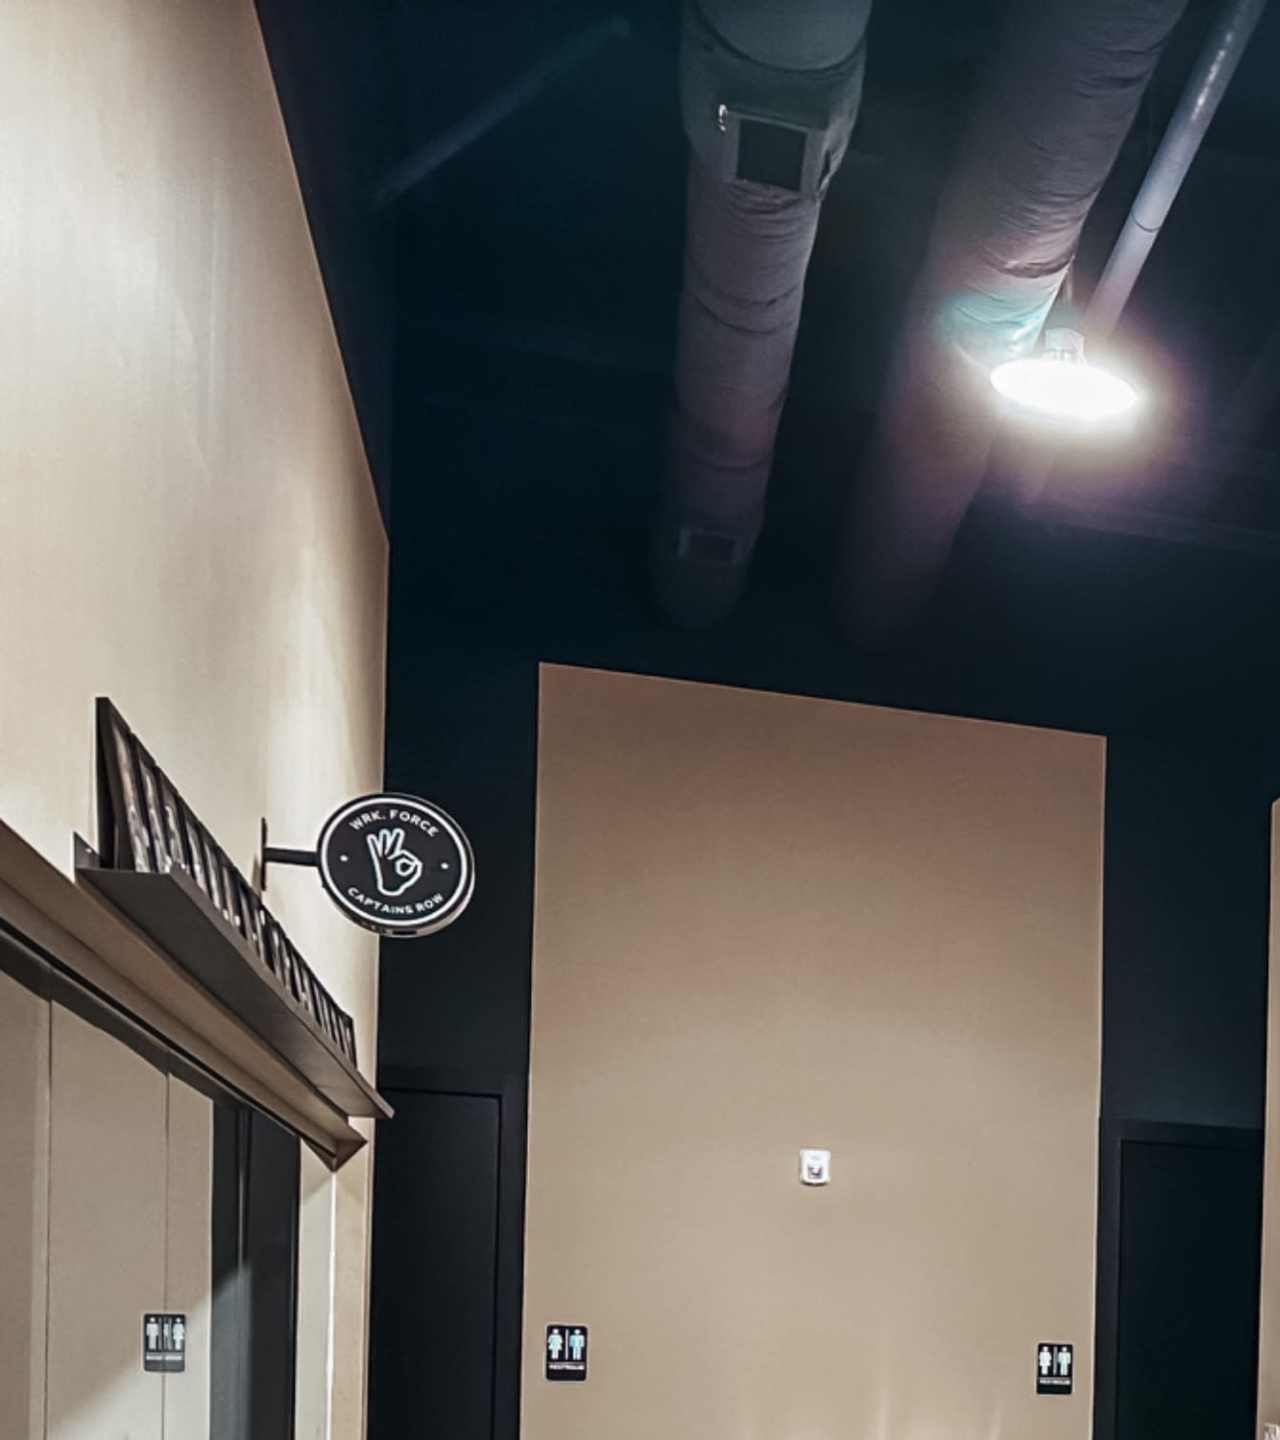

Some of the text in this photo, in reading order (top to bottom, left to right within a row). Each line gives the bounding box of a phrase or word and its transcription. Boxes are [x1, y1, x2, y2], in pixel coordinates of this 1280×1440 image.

[389, 809, 439, 837] FORCE
[347, 887, 443, 914] CAPTAINS ROW
